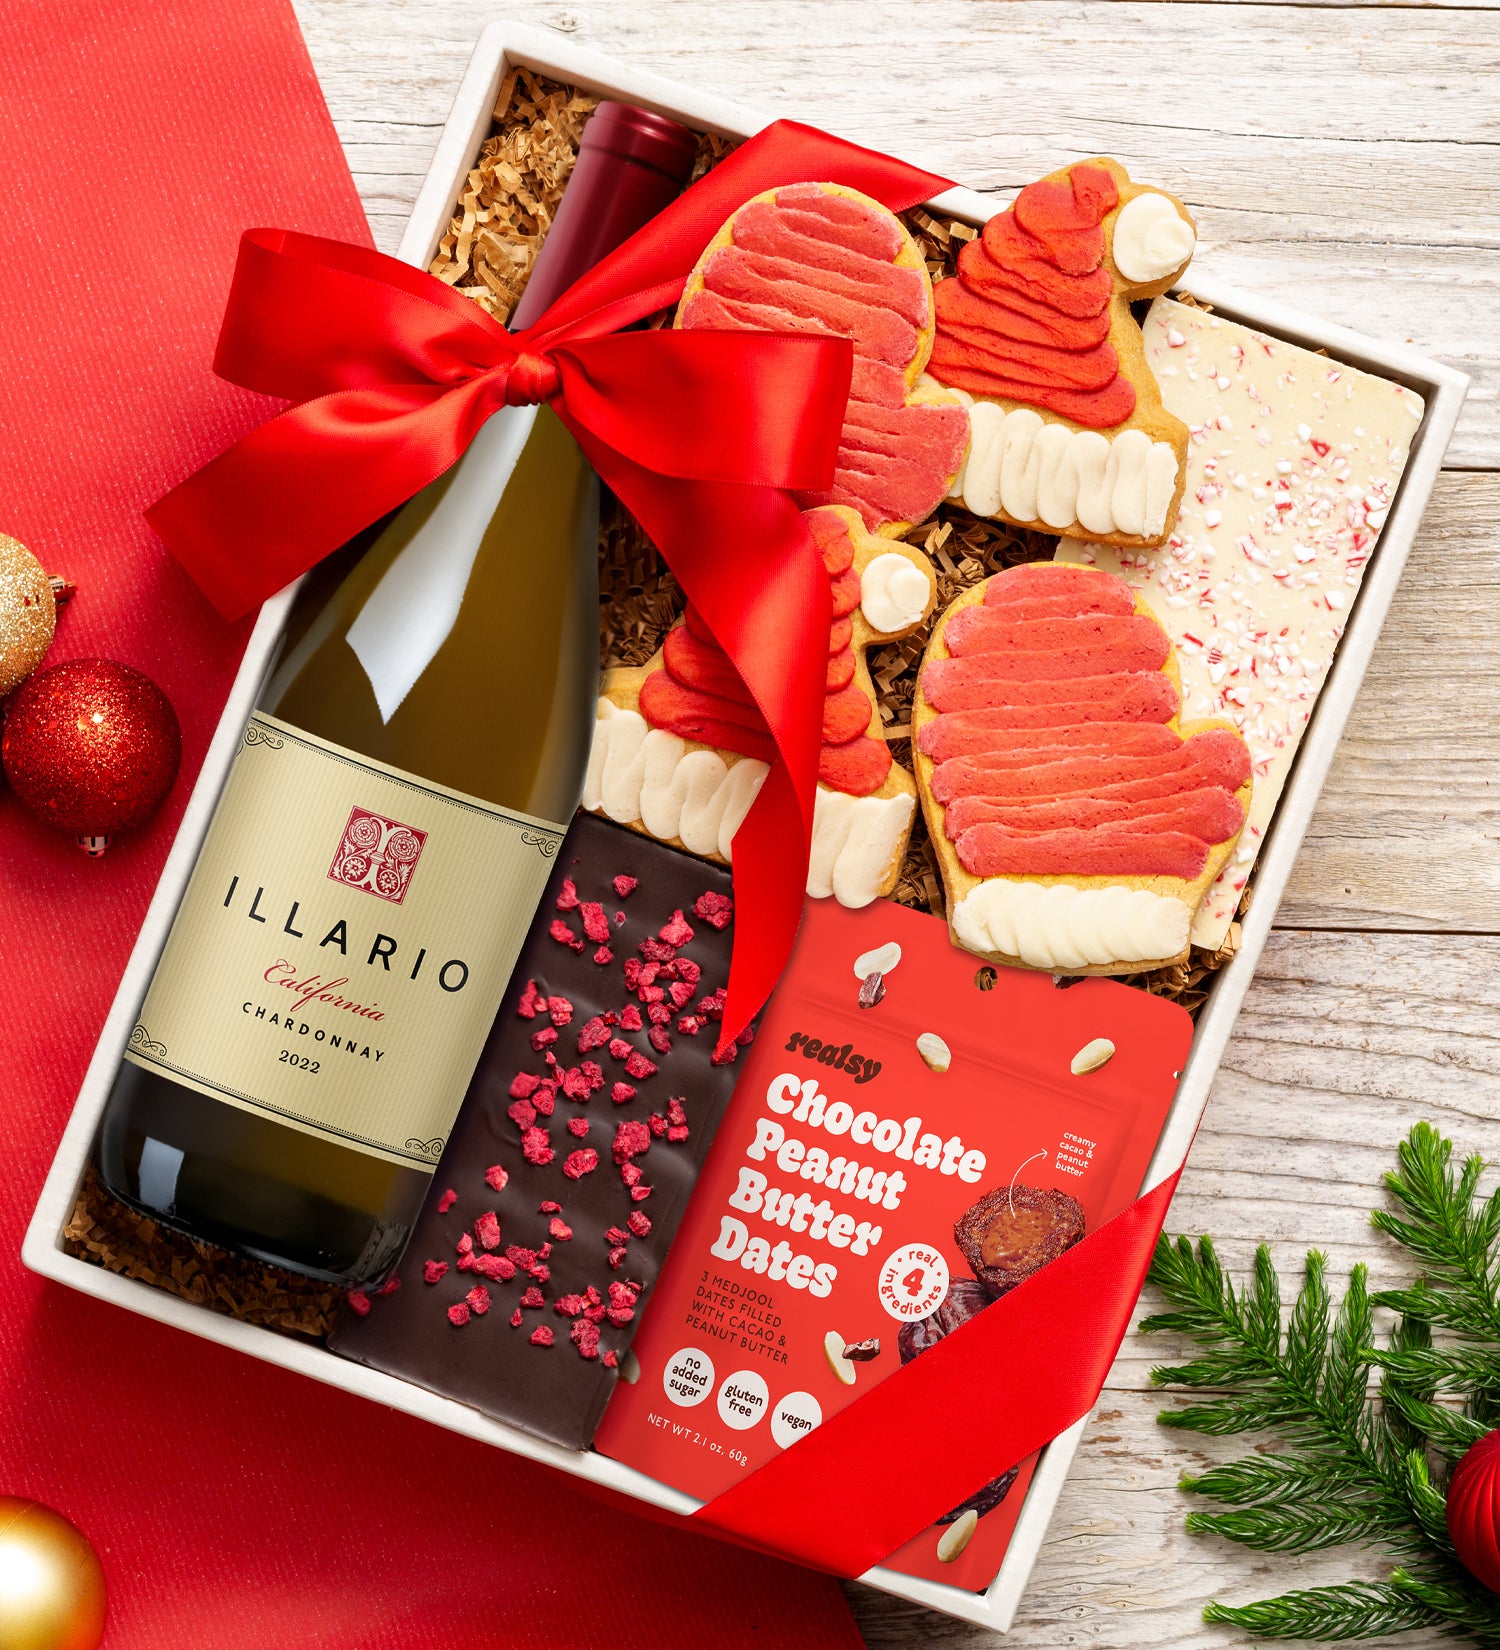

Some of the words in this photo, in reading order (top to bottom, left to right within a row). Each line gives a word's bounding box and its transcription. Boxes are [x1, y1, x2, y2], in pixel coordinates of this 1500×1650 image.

[223, 876, 469, 992] ILLARIO
[264, 959, 385, 1021] California
[242, 1002, 385, 1062] CHARDONNAY
[279, 1050, 320, 1074] 2022
[785, 1032, 882, 1084] realsy
[766, 1073, 987, 1184] Chocolate
[1064, 1132, 1096, 1149] creamy
[746, 1117, 907, 1210] Peanut
[1056, 1160, 1084, 1177] butter
[1057, 1152, 1088, 1168] peanut
[1060, 1142, 1084, 1155] cacao
[1086, 1150, 1093, 1159] &
[728, 1166, 883, 1256] Butter
[710, 1215, 838, 1298] Dates
[909, 1250, 938, 1267] real
[701, 1271, 709, 1282] 3
[712, 1276, 774, 1309] MEDJOOL
[881, 1268, 941, 1315] ingredients
[902, 1268, 925, 1297] 4
[692, 1300, 725, 1322] WITH
[729, 1316, 774, 1341] CACAO
[778, 1335, 786, 1347] &
[696, 1286, 735, 1310] DATES
[739, 1303, 782, 1328] FILLED
[685, 1314, 737, 1343] PEANUT
[740, 1337, 789, 1365] BUTTER
[672, 1365, 708, 1387] added
[685, 1357, 701, 1370] no
[669, 1378, 701, 1397] sugar
[724, 1385, 763, 1407] gluten
[728, 1399, 752, 1417] free
[781, 1411, 812, 1431] vegan
[647, 1413, 670, 1430] NET
[672, 1423, 692, 1439] WT
[693, 1432, 707, 1447] 2.1
[709, 1442, 725, 1456] oz,
[728, 1448, 748, 1467] 60g
